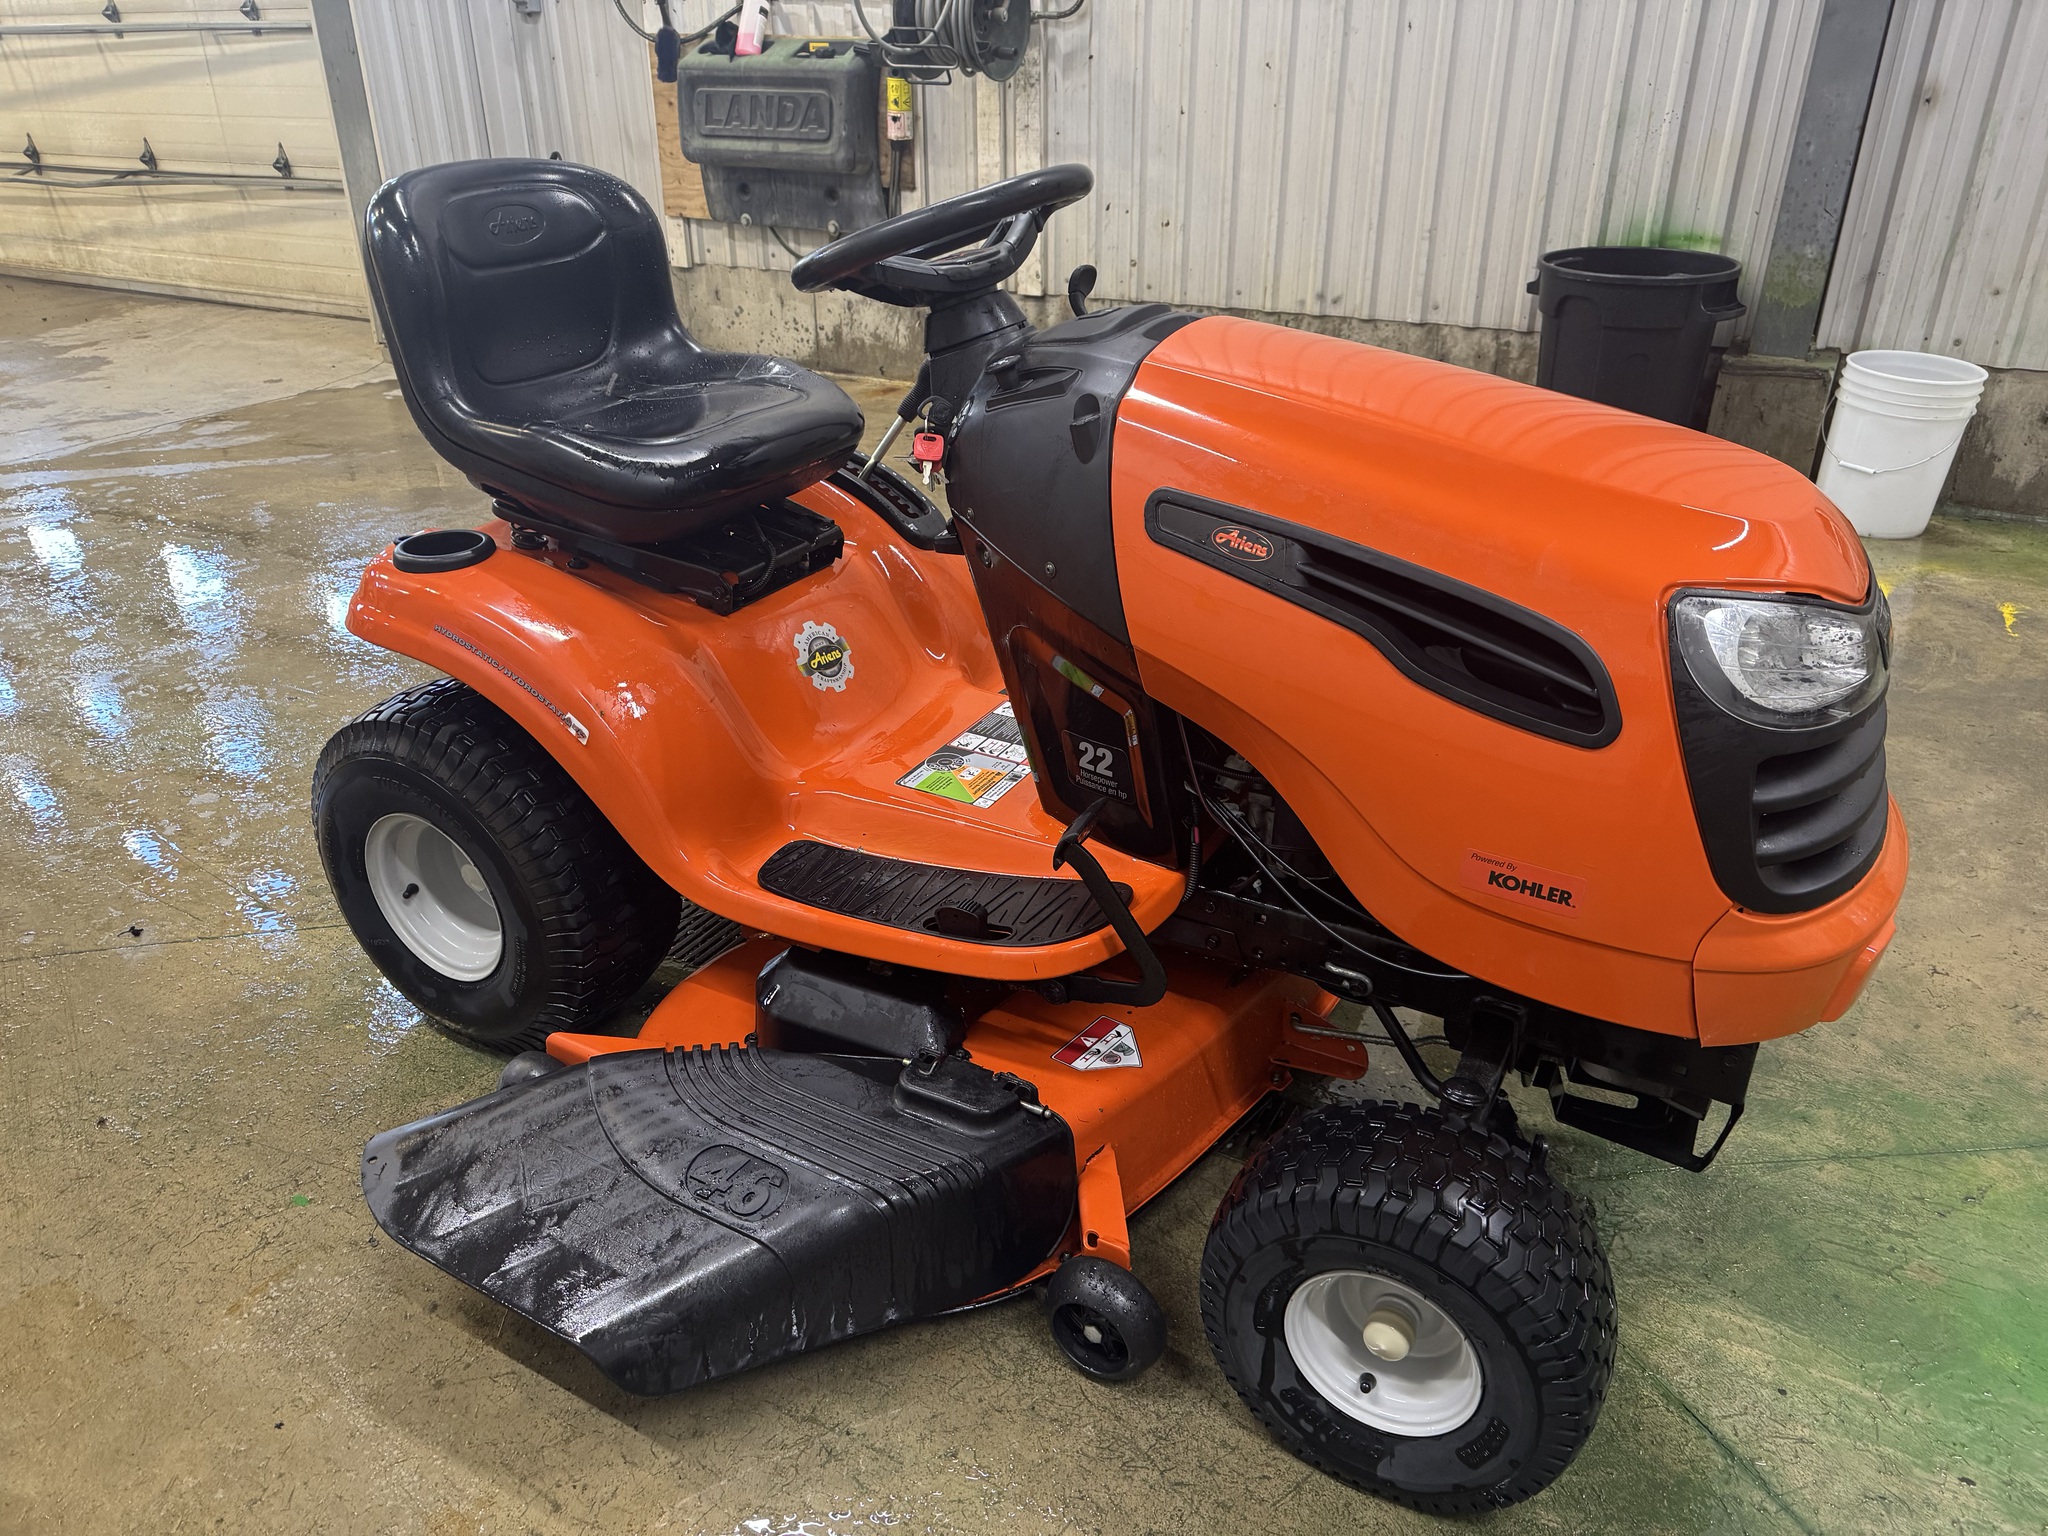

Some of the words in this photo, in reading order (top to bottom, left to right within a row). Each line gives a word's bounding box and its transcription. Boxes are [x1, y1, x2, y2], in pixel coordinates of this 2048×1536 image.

[704, 94, 827, 133] LANDA
[1215, 530, 1268, 558] Ariens
[810, 649, 842, 669] Ariens
[1078, 741, 1113, 778] 22
[1075, 774, 1107, 793] Puissance
[1108, 788, 1117, 796] en
[1118, 789, 1127, 799] hp
[1080, 769, 1118, 788] Horsepower
[1470, 852, 1505, 868] Powered
[1506, 862, 1518, 872] By
[688, 1156, 785, 1217] 46
